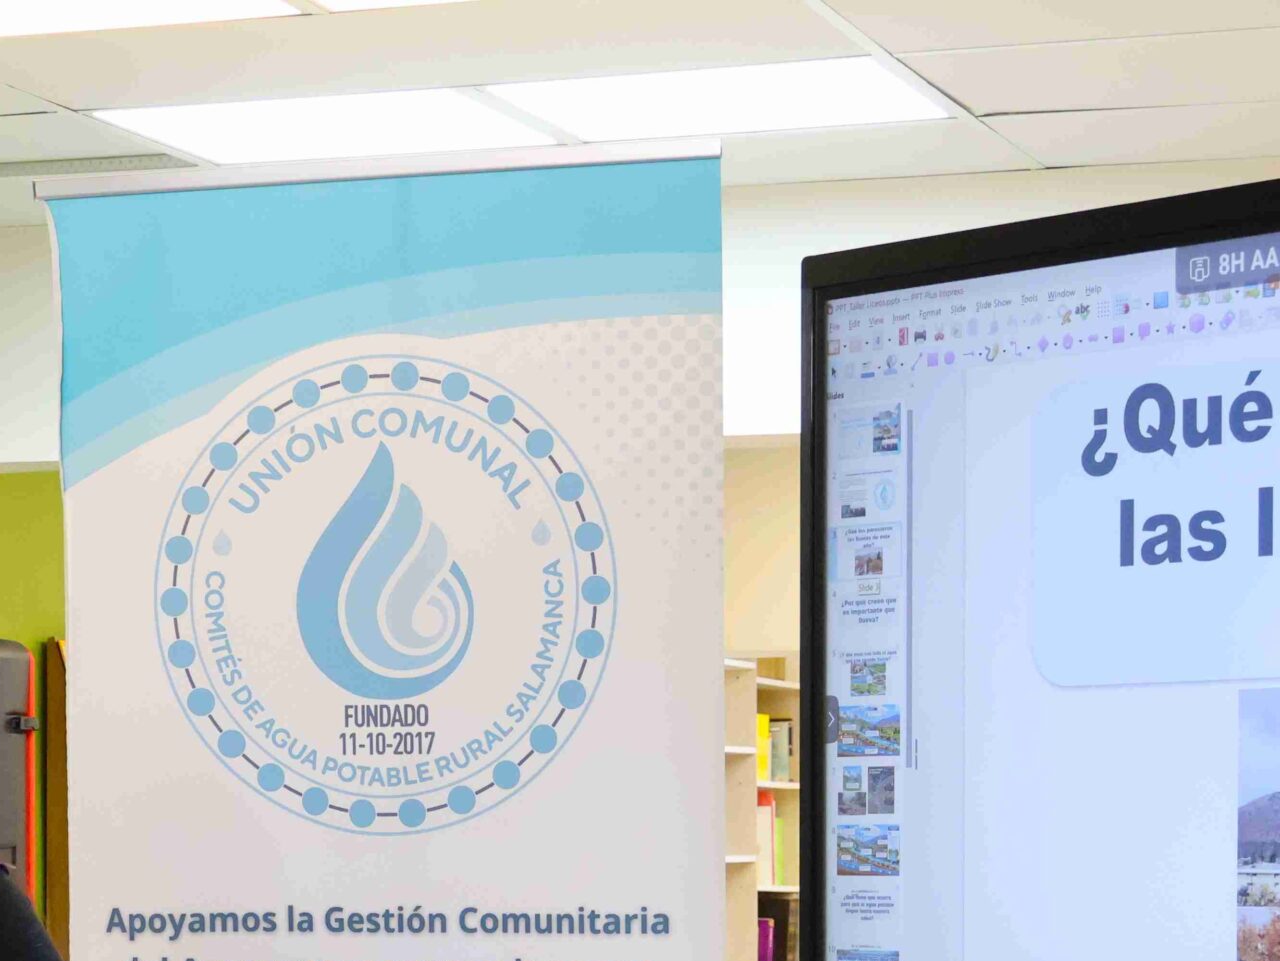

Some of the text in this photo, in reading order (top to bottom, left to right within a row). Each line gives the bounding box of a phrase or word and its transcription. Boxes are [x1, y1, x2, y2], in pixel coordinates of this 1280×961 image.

[1219, 254, 1245, 274] 8H
[848, 319, 860, 330] Edit
[869, 316, 884, 327] View
[892, 312, 910, 323] Insert
[920, 308, 941, 320] Format
[951, 304, 966, 314] Slide
[976, 301, 991, 312] Slide
[994, 299, 1012, 309] Show
[1021, 294, 1038, 305] Tools
[1048, 288, 1075, 300] Window
[1085, 284, 1101, 296] Help
[1081, 370, 1273, 476] ¿Qué
[228, 407, 531, 514] UNIÓN COMUNAL
[1120, 499, 1227, 566] las
[204, 558, 564, 787] COMITÉS DE AGUA POTABLE RURAL SALAMANCA
[344, 704, 430, 728] FUNDADO
[339, 731, 436, 756] 11-10-2017
[106, 906, 671, 942] Apoyamos la Gestión Comunitaria
